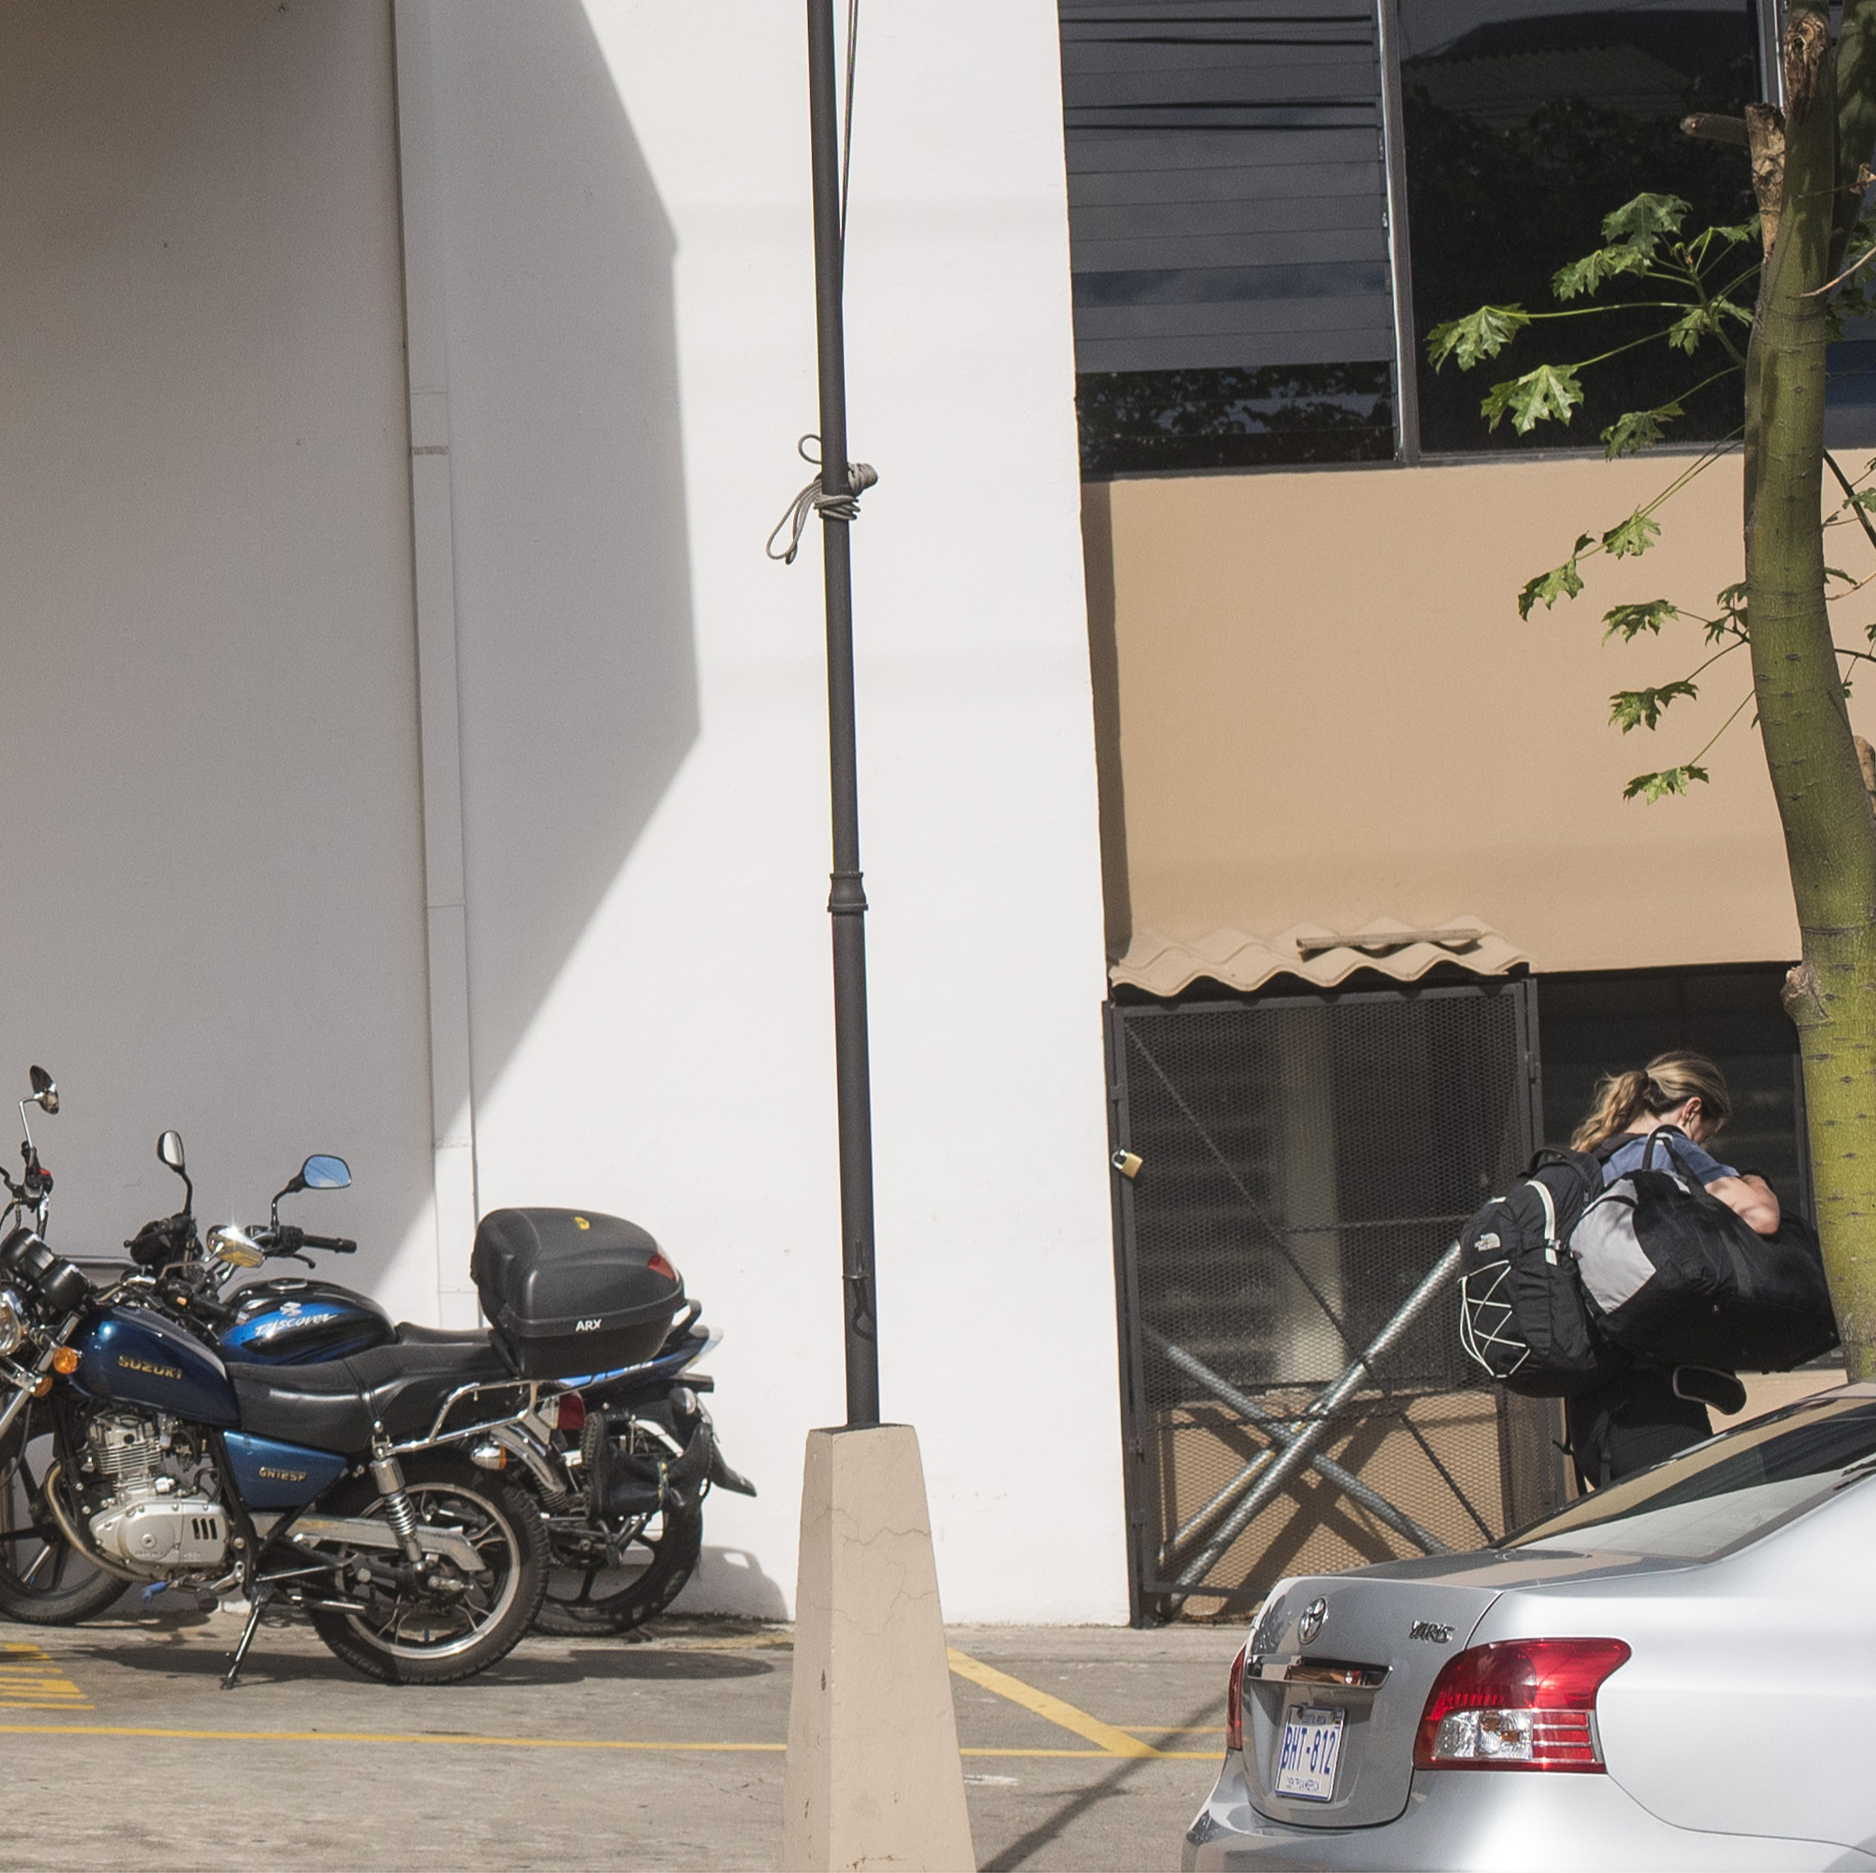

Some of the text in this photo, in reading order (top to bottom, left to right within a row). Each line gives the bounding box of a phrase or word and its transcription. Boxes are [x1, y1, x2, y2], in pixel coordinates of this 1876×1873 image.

[575, 1318, 602, 1332] ARX
[117, 1355, 184, 1380] SUZUKI
[1408, 1620, 1456, 1644] YARIS
[1281, 1725, 1336, 1775] BHT-812
